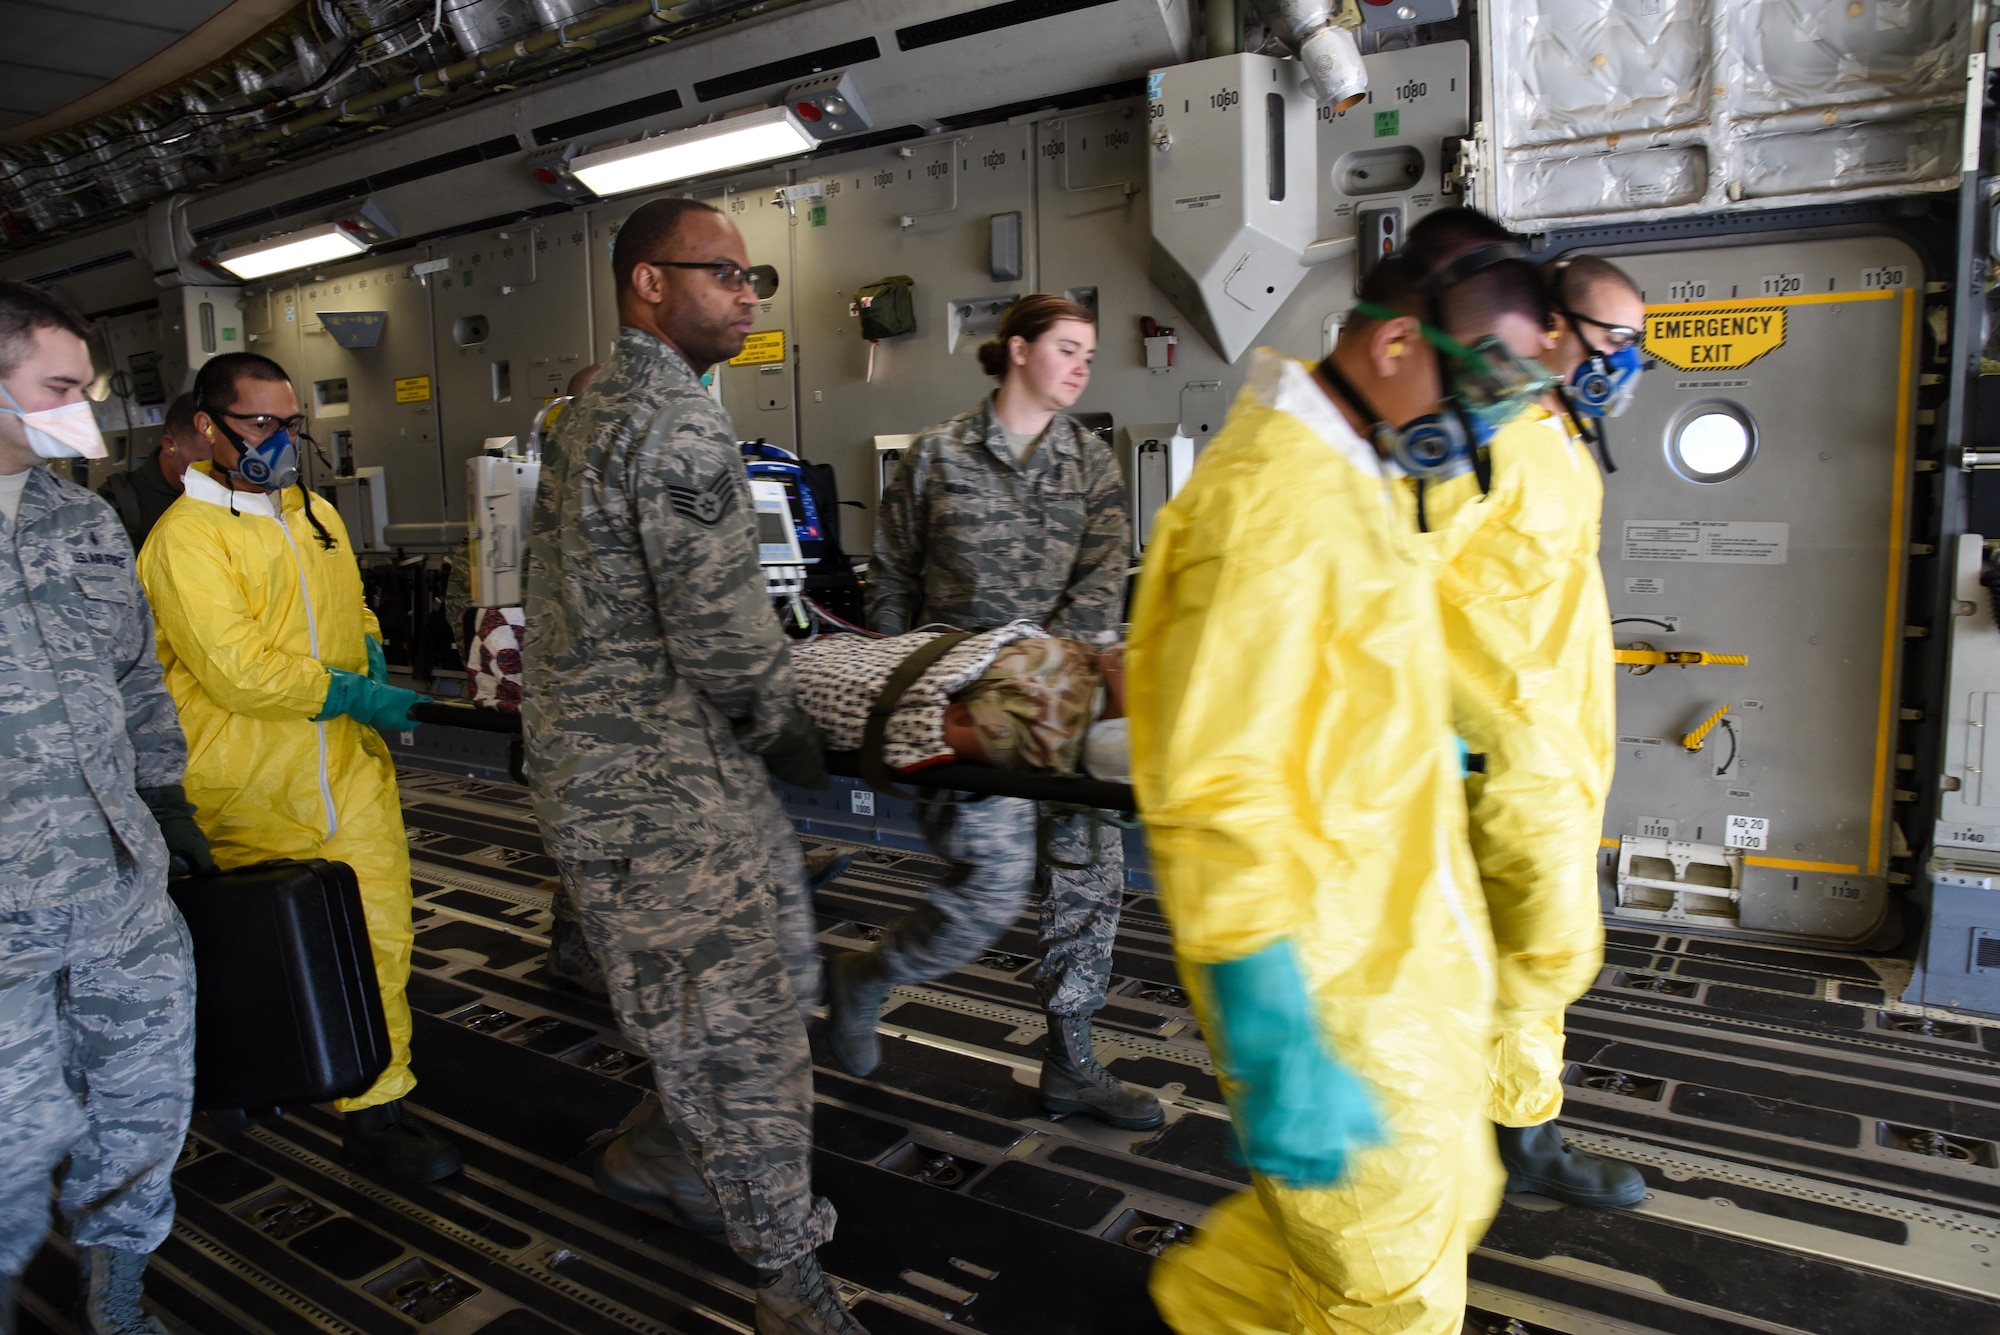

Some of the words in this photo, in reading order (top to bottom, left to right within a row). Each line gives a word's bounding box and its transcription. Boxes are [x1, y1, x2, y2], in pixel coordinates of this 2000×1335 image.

[1396, 82, 1427, 100] 1080
[1210, 91, 1239, 109] 1060
[1104, 131, 1129, 147] 1040
[1042, 142, 1065, 157] 1030
[983, 152, 1005, 168] 1020
[926, 162, 948, 177] 1010
[873, 173, 894, 187] 1000
[825, 182, 841, 196] 990
[731, 200, 746, 213] 970
[1764, 277, 1800, 293] 1120
[1865, 271, 1902, 286] 1130
[1671, 284, 1705, 299] 1110
[1654, 315, 1773, 340] EMERGENCY
[1691, 344, 1733, 363] EXIT
[1643, 825, 1669, 837] 1110
[1750, 819, 1764, 830] 20
[1732, 834, 1760, 848] 1120
[1953, 832, 1985, 843] 1140
[1832, 886, 1860, 899] 1130
